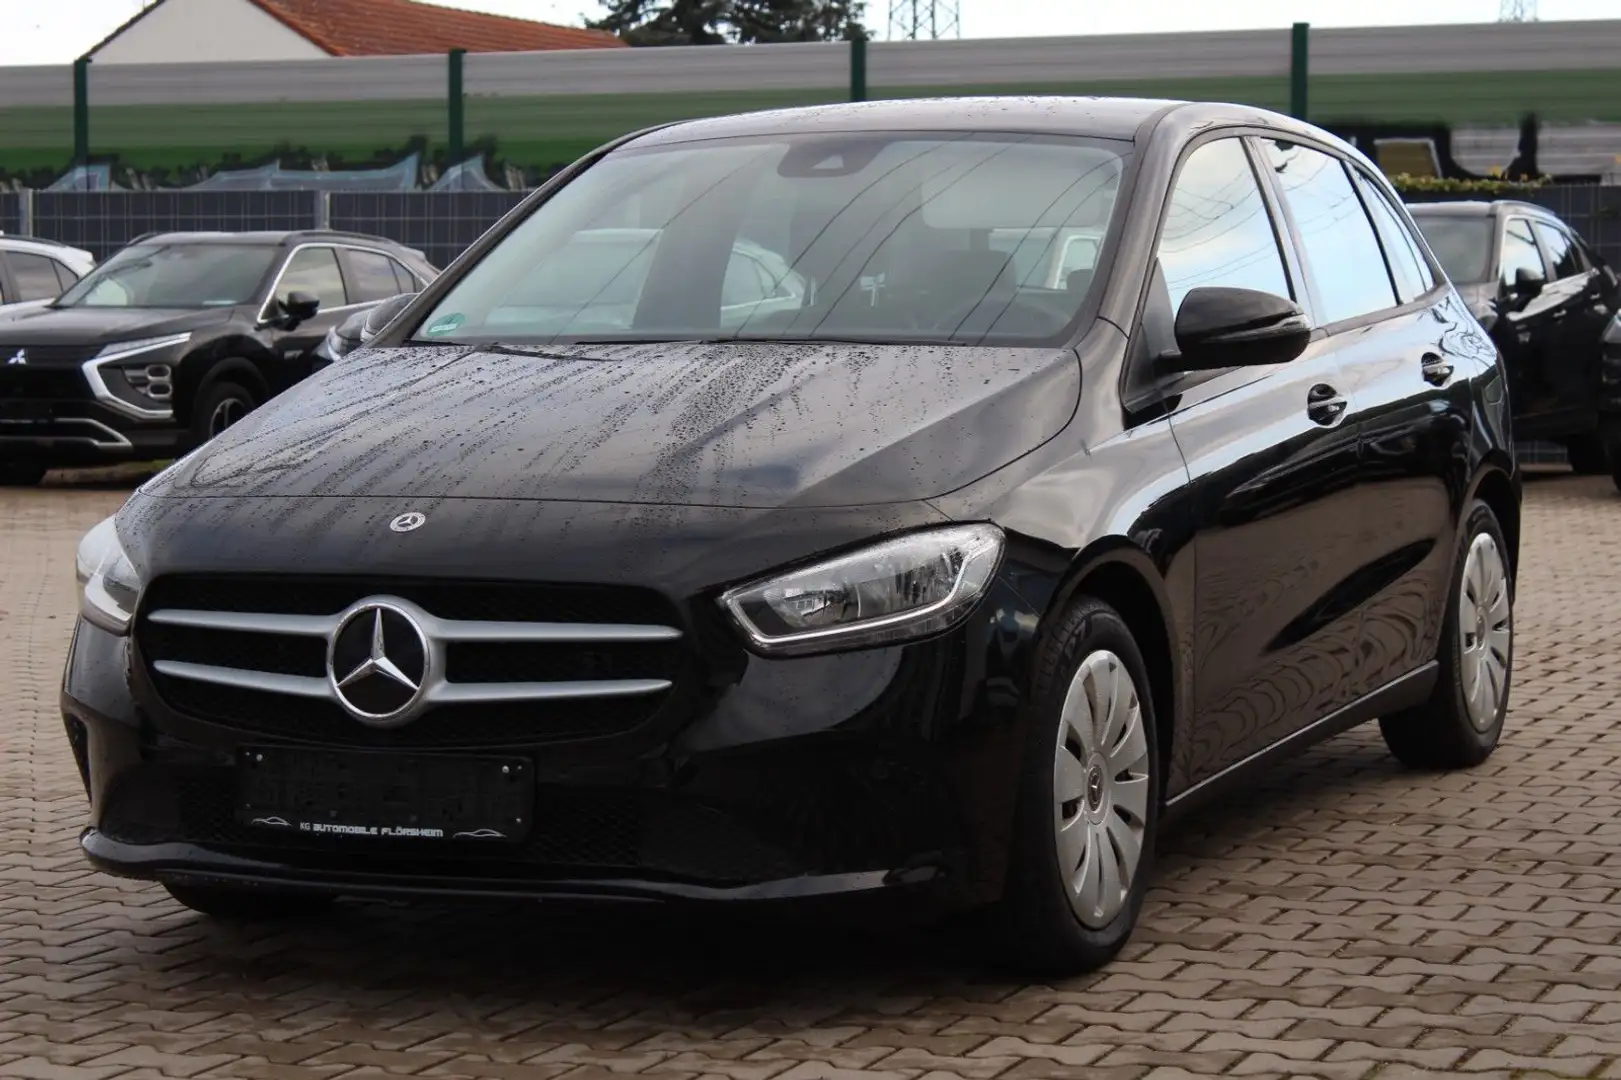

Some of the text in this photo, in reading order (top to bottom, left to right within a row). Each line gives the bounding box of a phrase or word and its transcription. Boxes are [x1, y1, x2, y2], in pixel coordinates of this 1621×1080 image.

[299, 822, 444, 837] KG AUTOMOBILE FLÖRSHEIM
